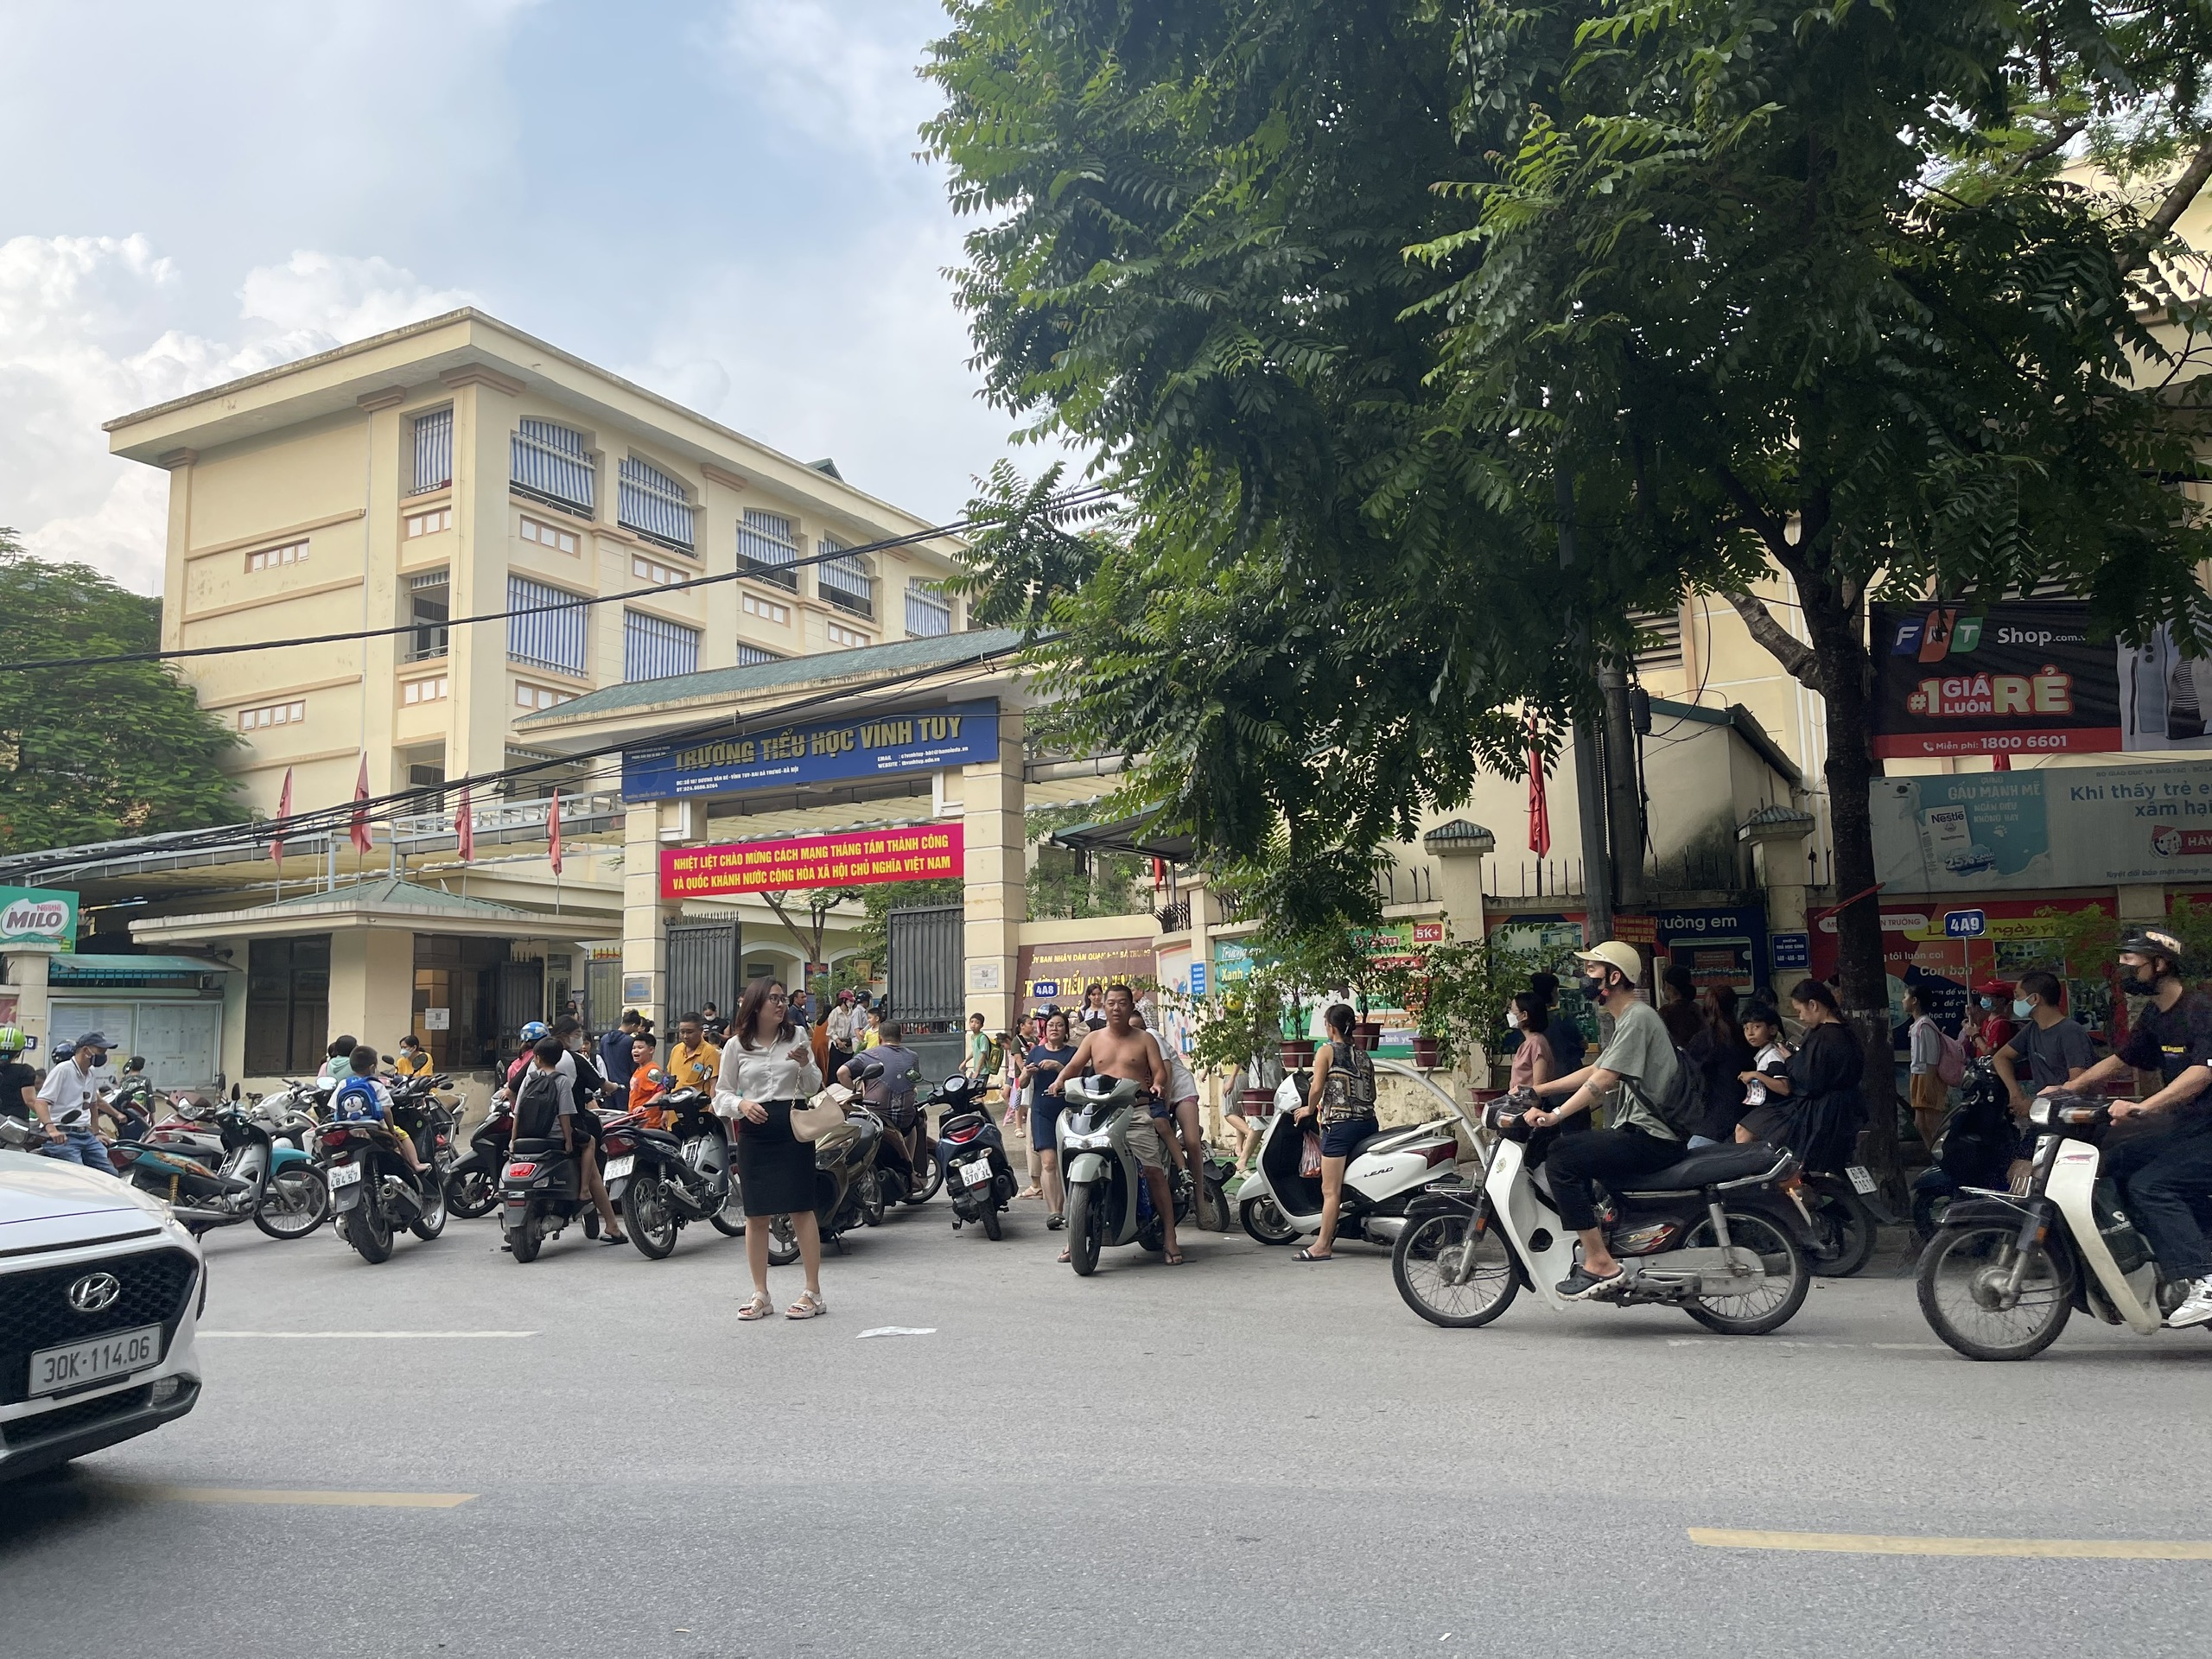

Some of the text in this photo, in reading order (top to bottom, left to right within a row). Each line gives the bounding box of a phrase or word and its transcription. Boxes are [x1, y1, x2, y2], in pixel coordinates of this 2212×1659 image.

[1942, 675, 1992, 697] GIÁ
[1993, 666, 2070, 714] RẺ
[1910, 680, 1940, 715] #1
[1944, 699, 1992, 714] LUÔN
[760, 728, 805, 761] TIỂU
[811, 729, 855, 758] HỌC
[918, 715, 962, 741] TUY
[1936, 734, 2067, 751] Miễn phí: 1800 6601
[2069, 785, 2104, 801] Khi
[2111, 782, 2156, 799] thấy
[2164, 780, 2191, 796] trẻ
[2135, 802, 2177, 817] xâm
[673, 833, 949, 871] NHIỆT LIỆT CHÀO MỪNG CÁCH MẠNG THÁNG TÁM THÀNH CÔNG
[1945, 855, 1974, 869] 25%
[672, 855, 950, 891] VÀ QUỐC KHÁNH NƯỚC CỘNG HÒA XÃ HỘI CHỦ NGHĨA VIỆT NAM
[6, 911, 62, 929] MILO
[1711, 917, 1738, 927] em
[1888, 917, 1921, 926] TRƯỜNG
[1950, 917, 1980, 931] 4A9
[1416, 928, 1440, 939] 5K+
[1054, 953, 1071, 963] NHÂN
[1073, 952, 1086, 961] DÂN
[1889, 950, 1902, 960] tôi
[1221, 967, 1243, 982] Xanh
[1919, 965, 1973, 977] Con bạn
[1063, 969, 1085, 995] TIỂU
[1036, 985, 1054, 995] 4A8
[1363, 1166, 1394, 1178] LEAD
[43, 1336, 150, 1384] 30K-114.06
